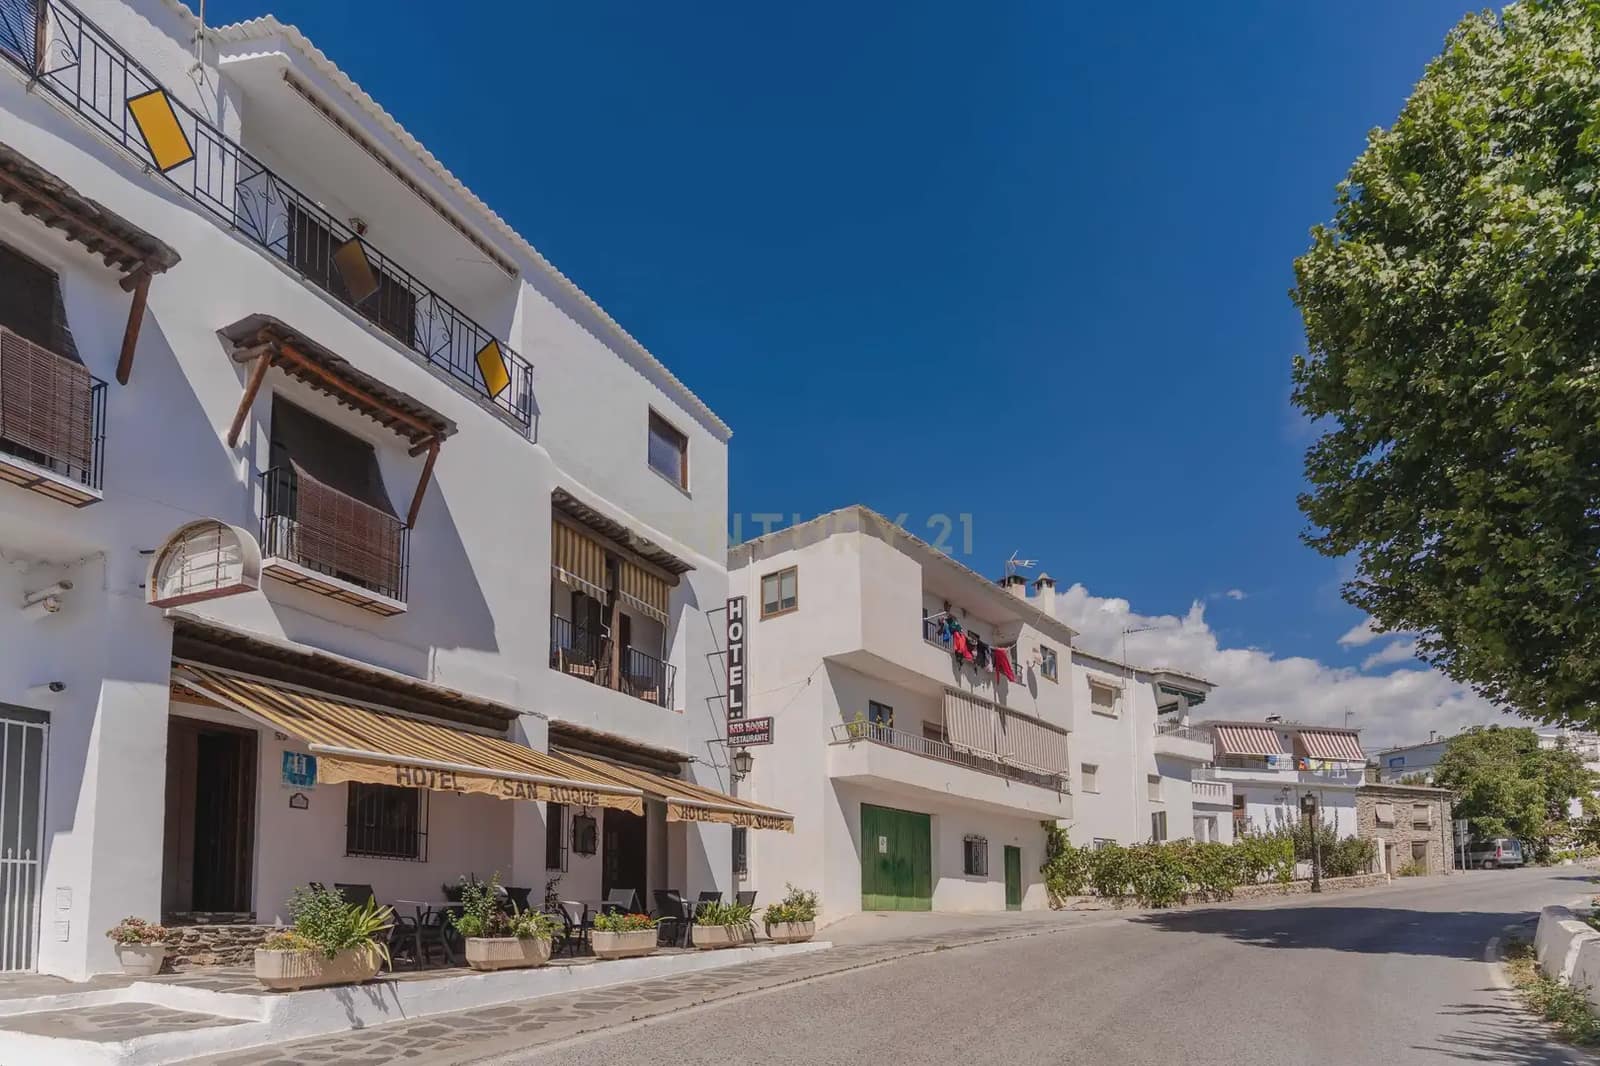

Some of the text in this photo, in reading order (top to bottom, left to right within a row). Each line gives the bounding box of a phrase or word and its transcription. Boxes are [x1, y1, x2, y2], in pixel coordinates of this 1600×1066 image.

[728, 601, 743, 708] HOTEL
[728, 733, 769, 744] RESTAURANTE
[396, 765, 465, 791] HOTEL
[502, 778, 538, 800] SAN
